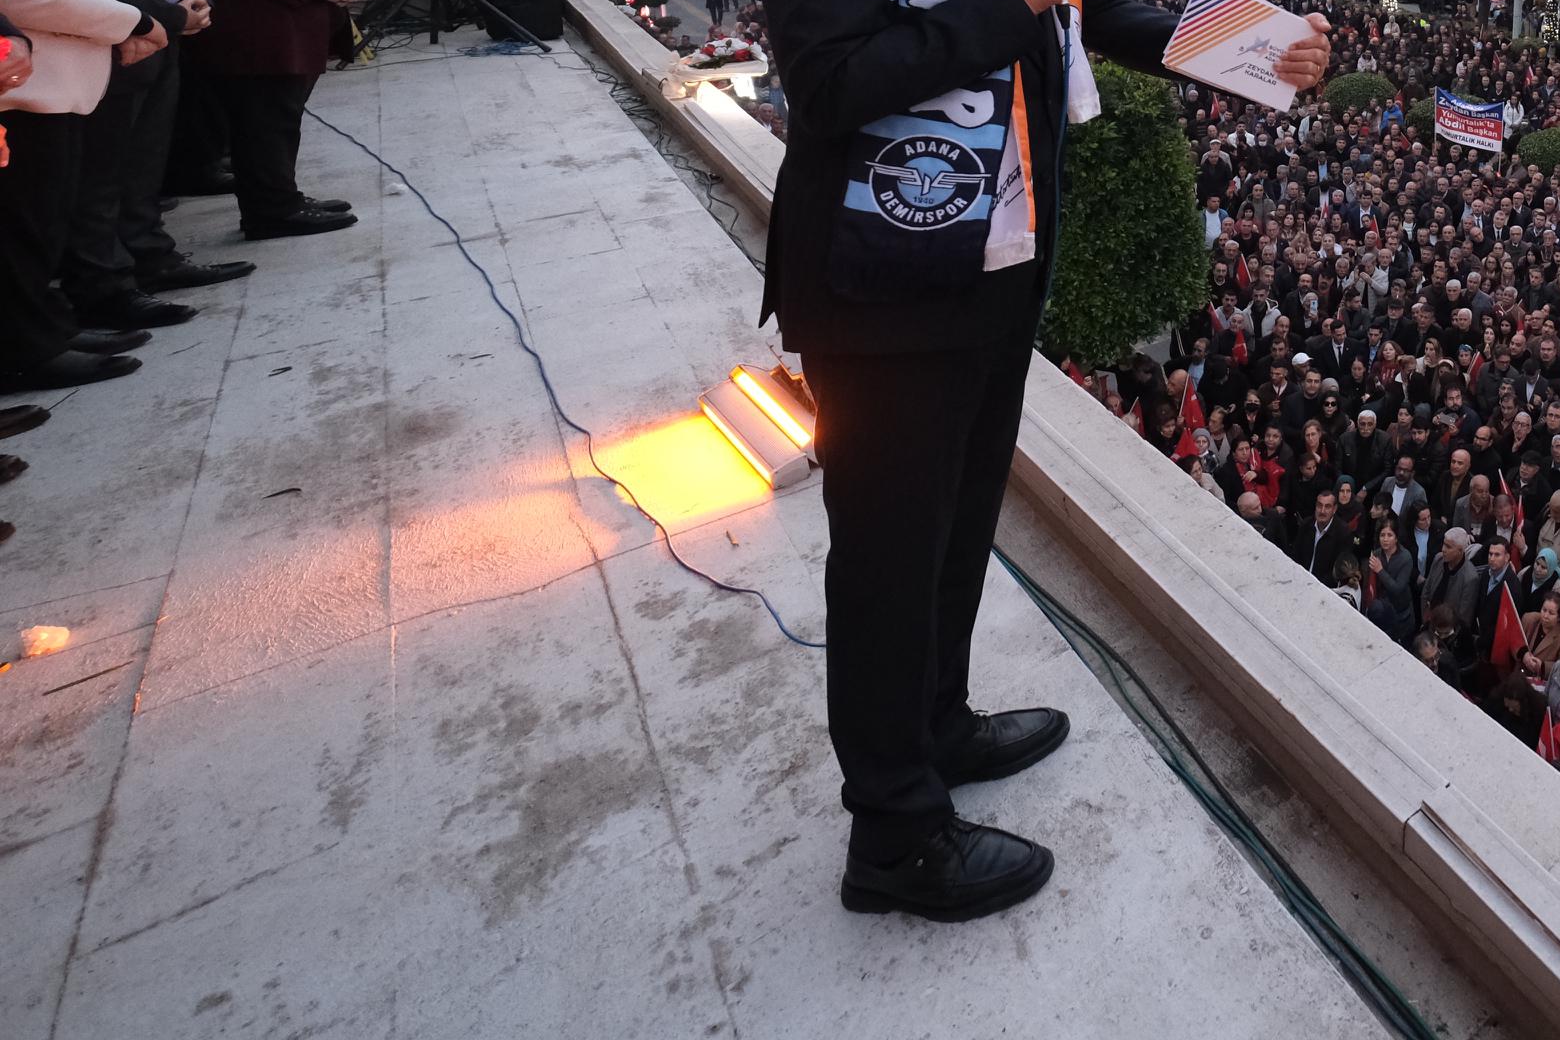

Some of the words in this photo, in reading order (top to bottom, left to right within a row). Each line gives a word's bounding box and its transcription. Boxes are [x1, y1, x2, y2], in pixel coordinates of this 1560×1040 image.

[1244, 70, 1277, 86] KARALAR
[1247, 63, 1275, 78] ZEYDAN
[1438, 96, 1470, 116] Zeydan
[1471, 110, 1499, 119] Başkan
[1439, 117, 1466, 131] Abdil
[1467, 126, 1498, 138] Başkan
[904, 140, 961, 161] ADANA
[1476, 138, 1494, 148] HALKI
[880, 190, 968, 223] DEMİRSPOR
[912, 195, 935, 205] 1940
